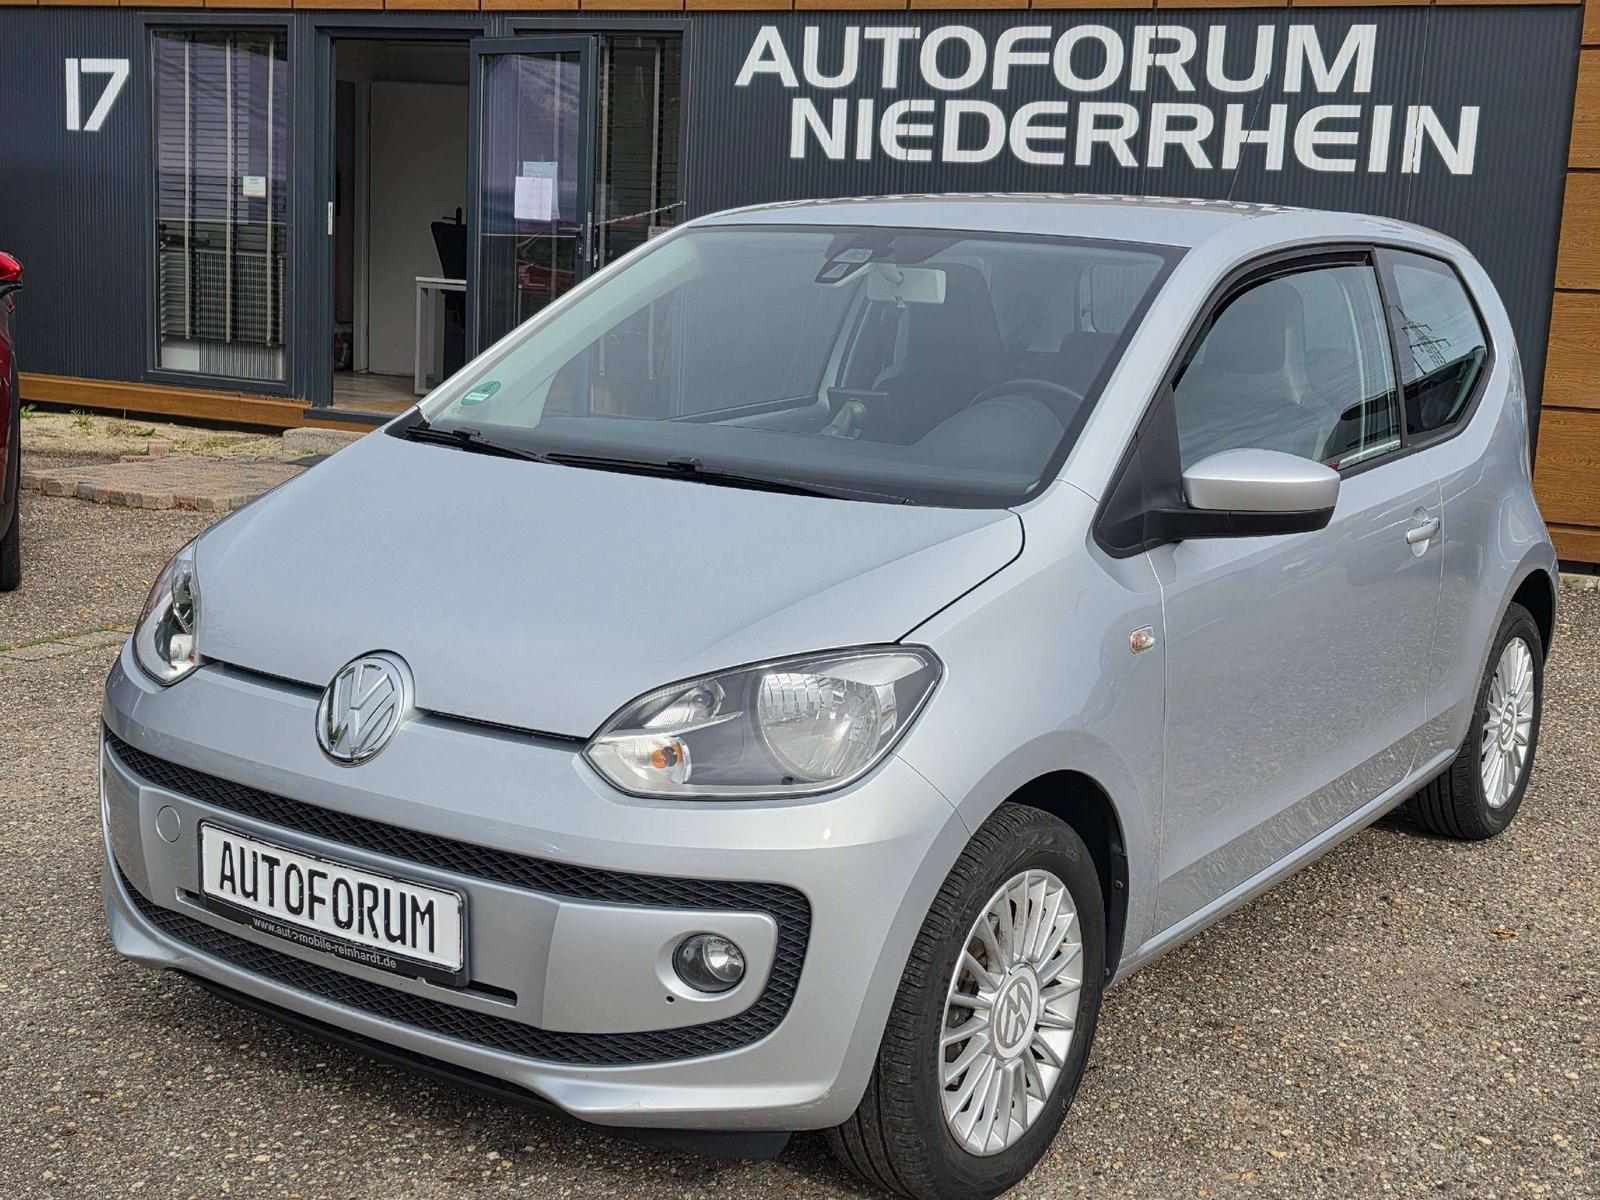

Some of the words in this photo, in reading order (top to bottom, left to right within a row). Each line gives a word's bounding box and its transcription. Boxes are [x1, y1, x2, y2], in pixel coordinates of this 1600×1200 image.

[65, 58, 129, 131] 17
[735, 25, 1377, 92] AUTOFORUM
[790, 98, 1480, 174] NIEDERRHEIN
[219, 840, 435, 953] AUTOFORUM
